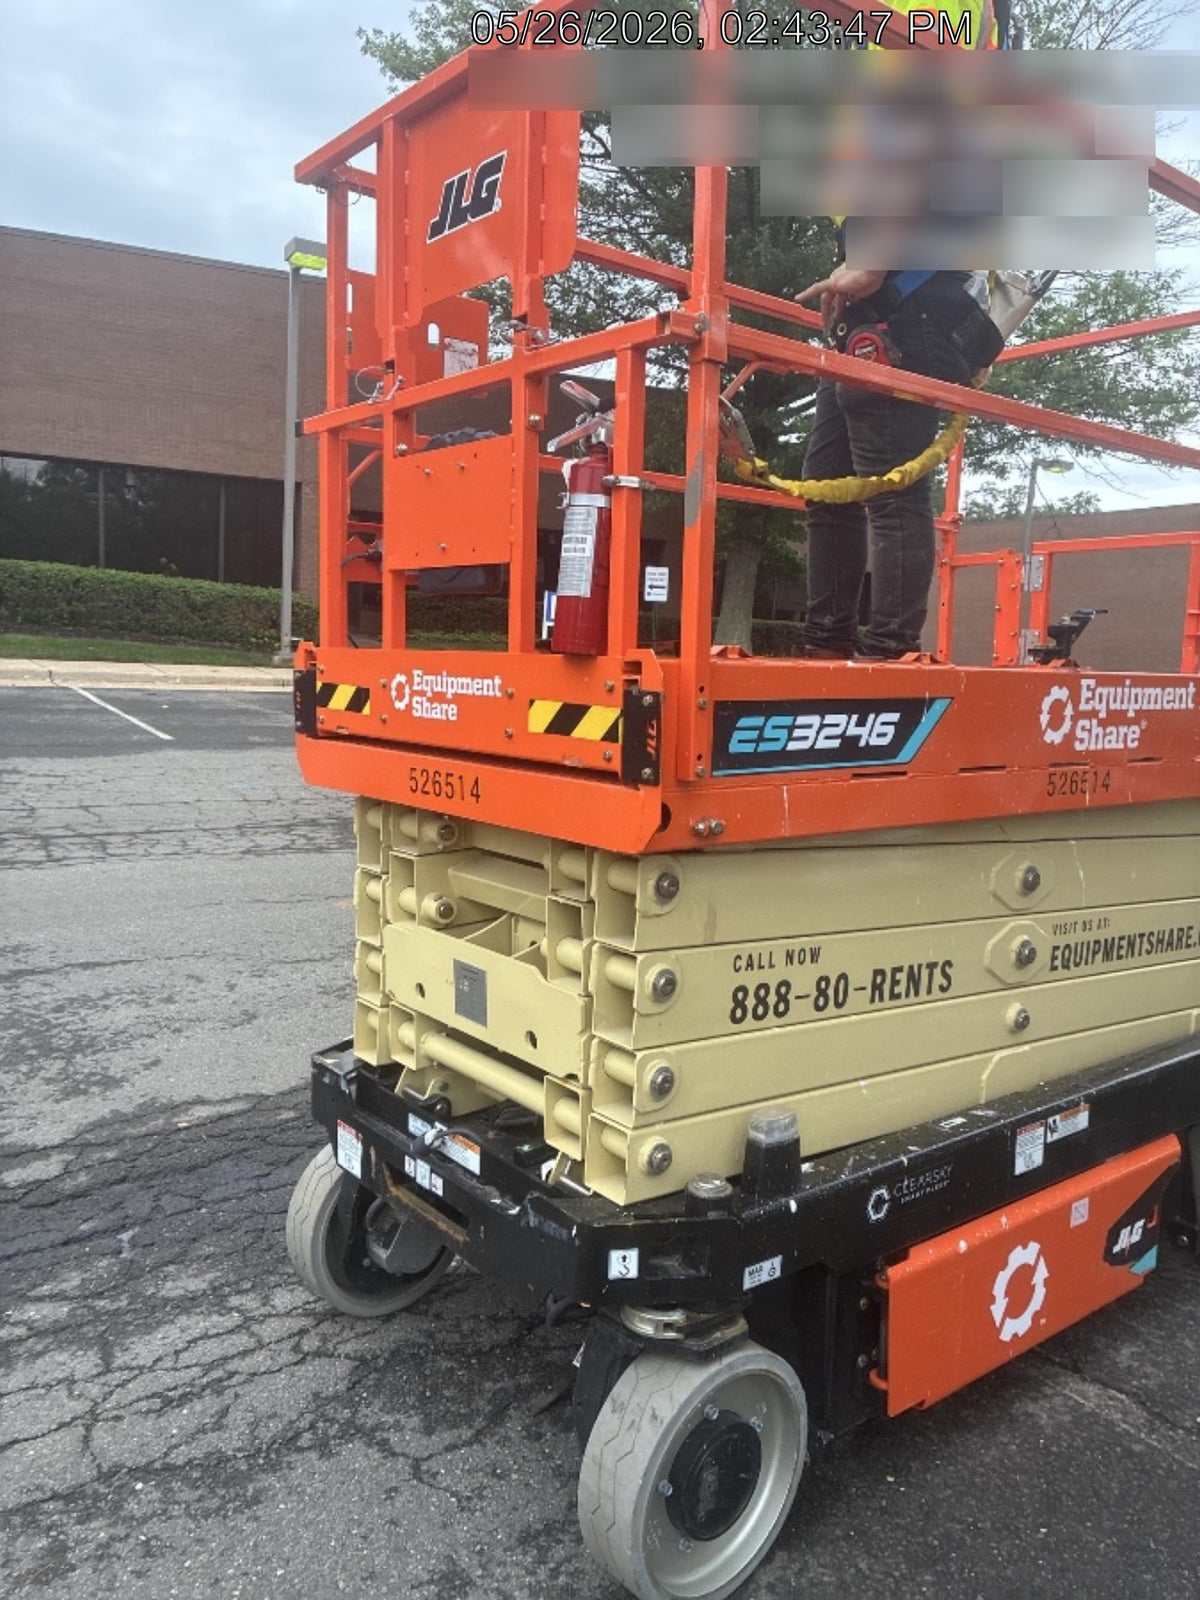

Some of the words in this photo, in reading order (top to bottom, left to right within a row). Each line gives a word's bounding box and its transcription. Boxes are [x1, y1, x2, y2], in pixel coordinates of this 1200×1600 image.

[426, 149, 508, 244] JLG
[412, 669, 502, 699] Equipment
[1079, 678, 1196, 718] Equipment
[411, 696, 458, 721] Share
[728, 712, 901, 754] ES3246
[1074, 718, 1141, 751] Share
[409, 767, 481, 804] 526514
[1046, 769, 1111, 797] 526514
[1052, 921, 1078, 936] VISIT
[733, 951, 776, 973] CALL
[785, 947, 821, 967] NOW
[1049, 925, 1200, 972] EQUIPMENTSHARE.
[729, 959, 954, 1025] 888-80-RENTS
[1112, 1218, 1146, 1255] JLG
